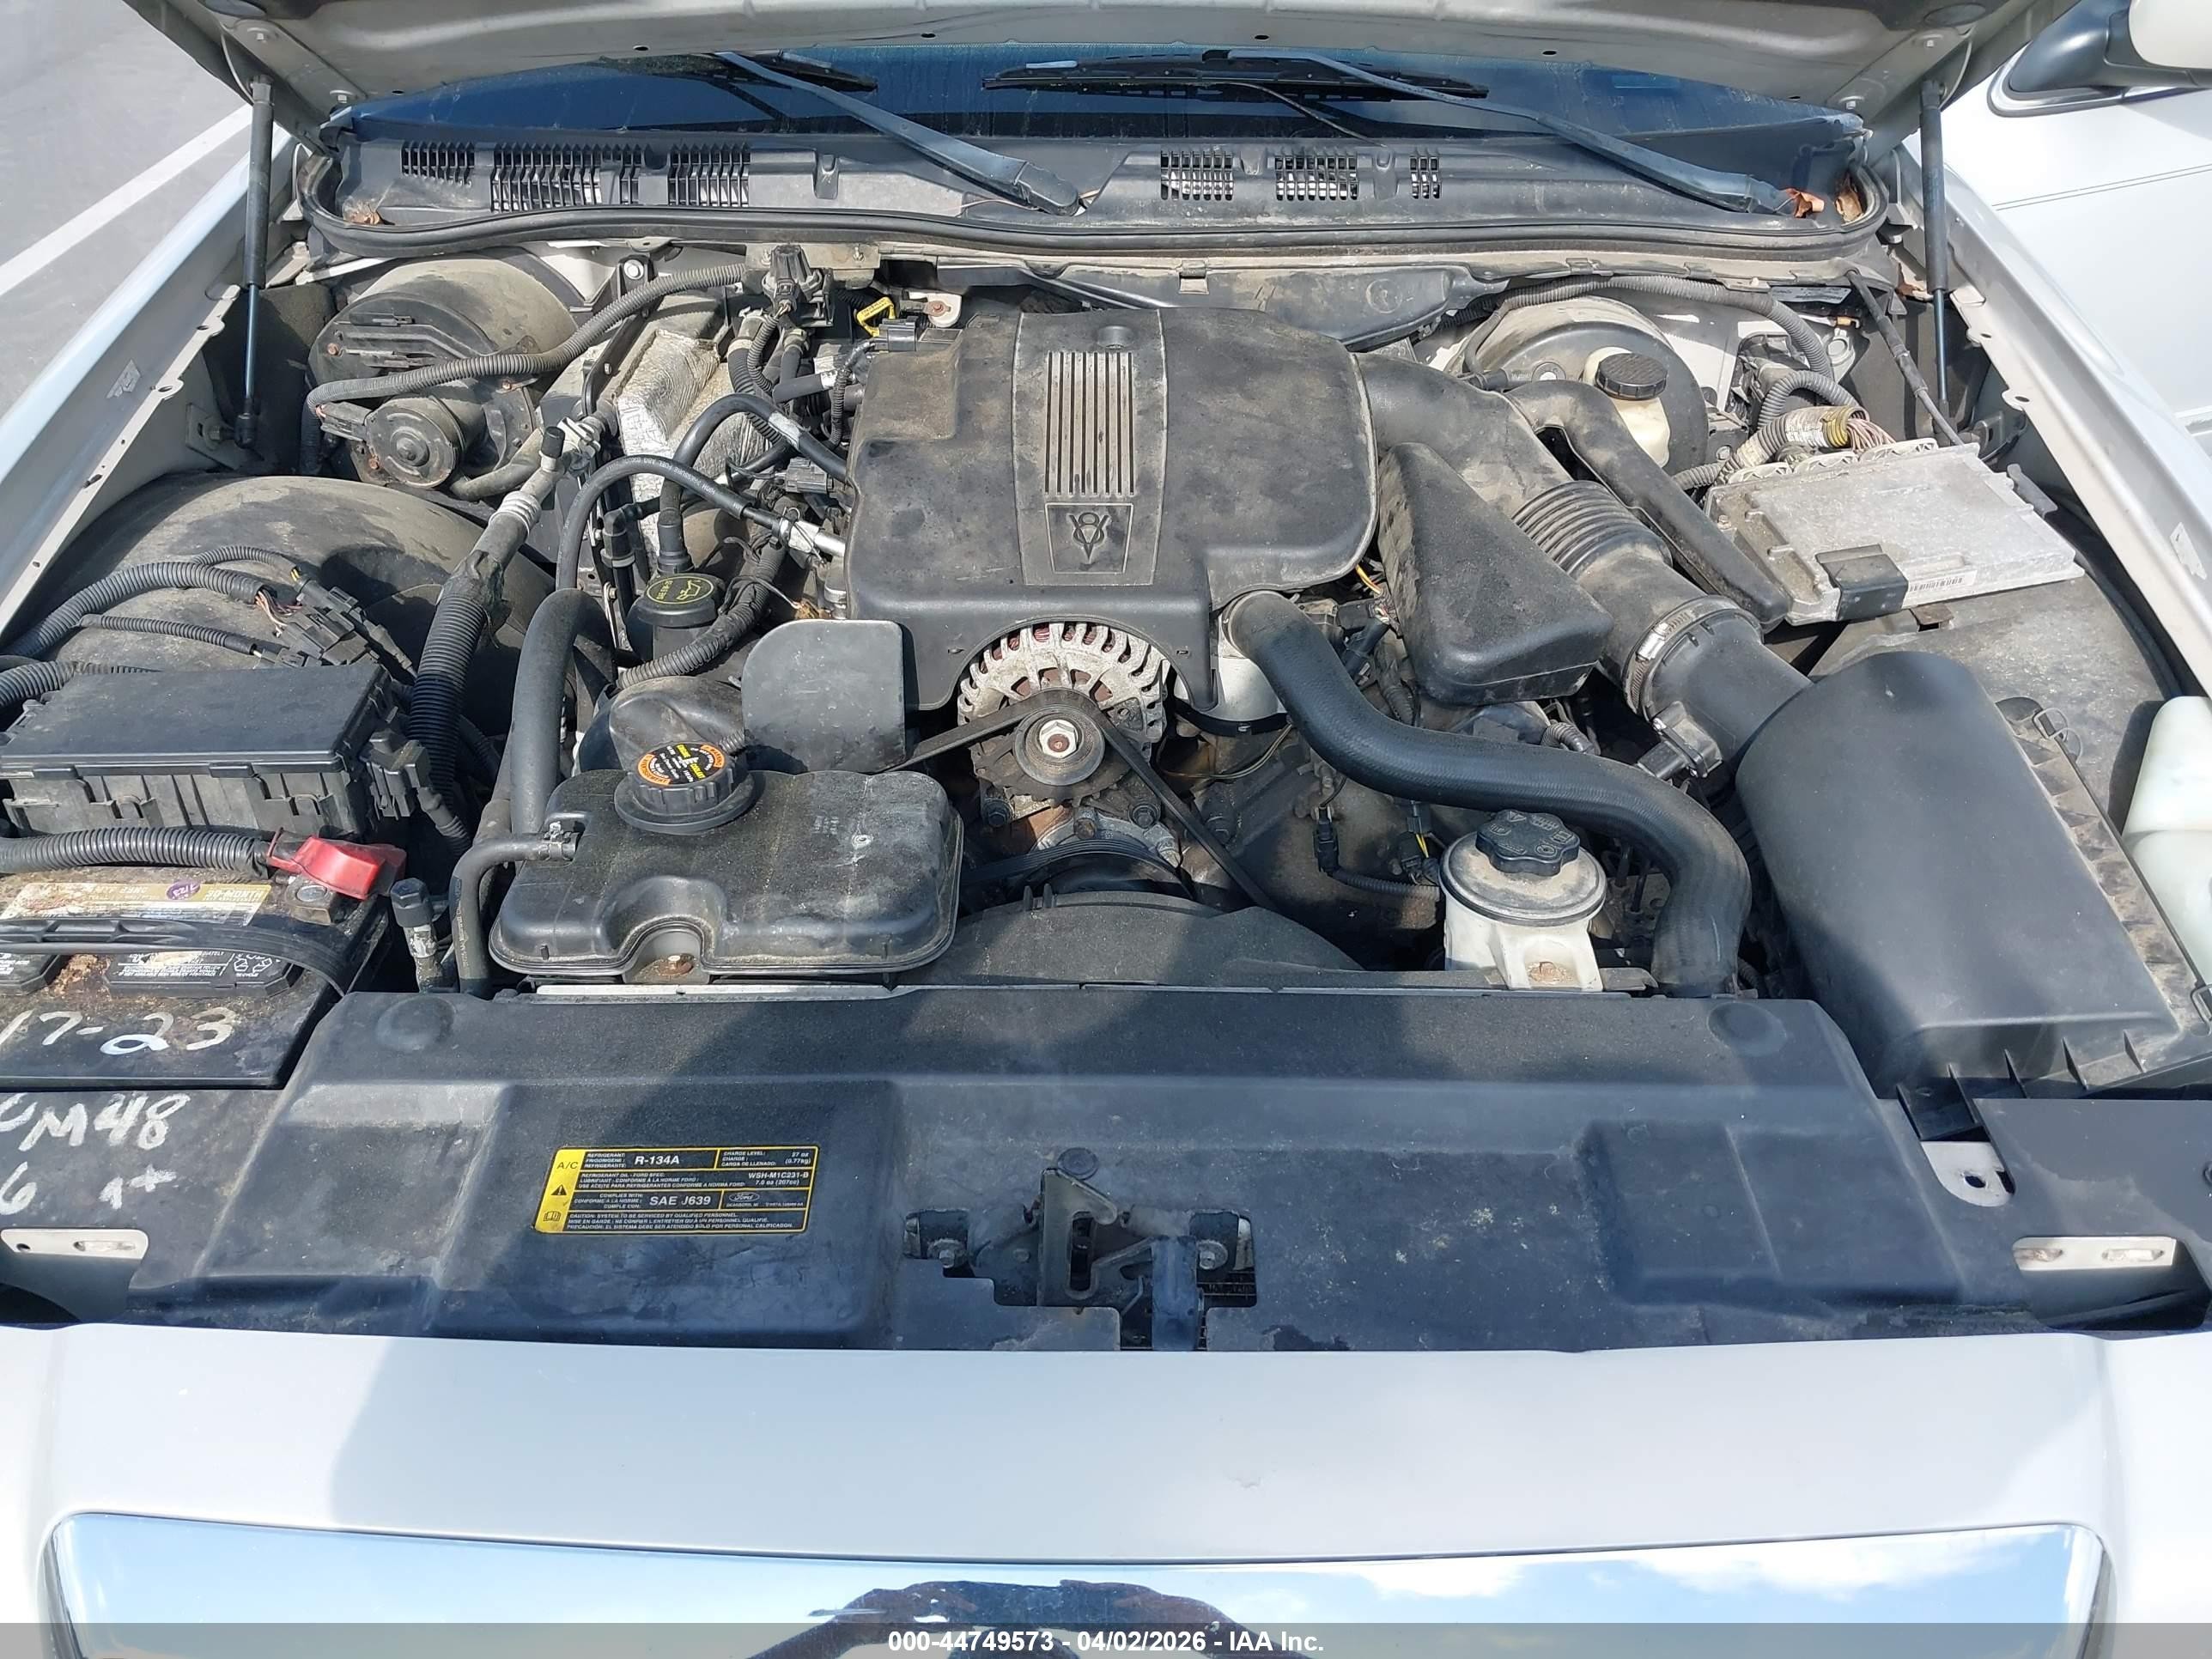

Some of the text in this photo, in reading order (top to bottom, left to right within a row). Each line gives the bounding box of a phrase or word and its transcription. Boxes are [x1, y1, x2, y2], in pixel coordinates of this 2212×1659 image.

[635, 1155, 680, 1165] R-134A
[649, 1195, 712, 1206] SAE J639
